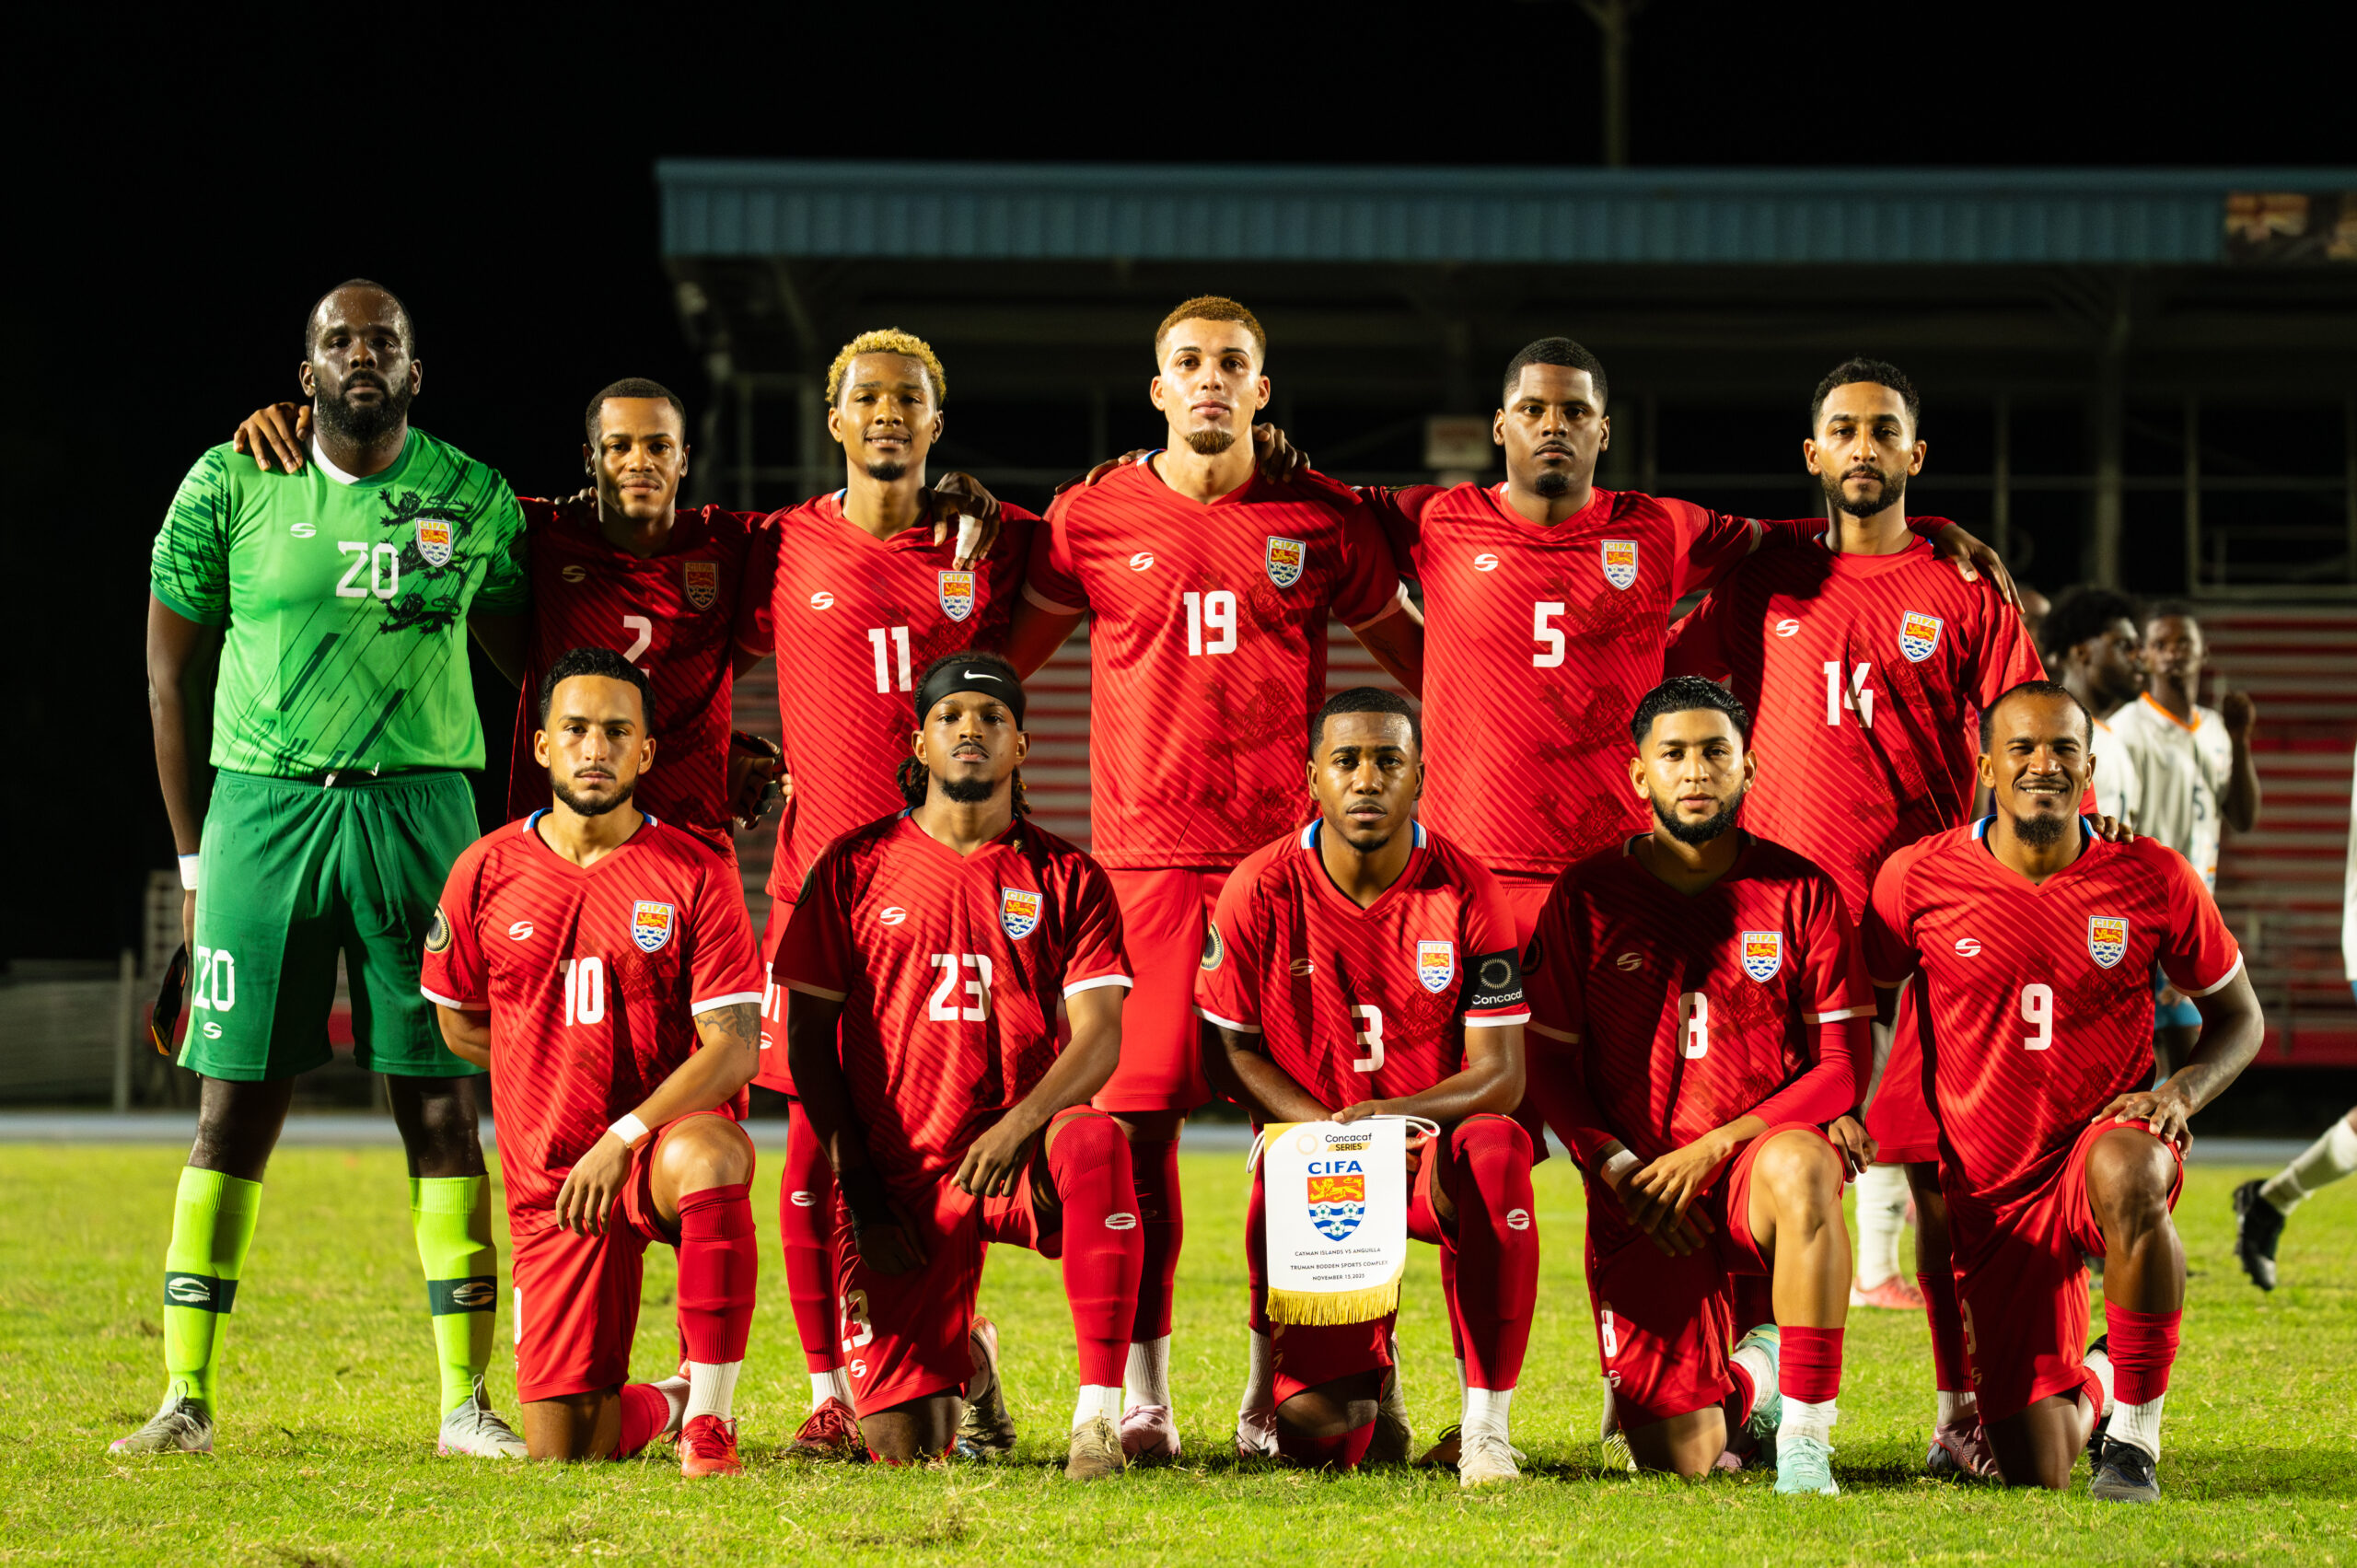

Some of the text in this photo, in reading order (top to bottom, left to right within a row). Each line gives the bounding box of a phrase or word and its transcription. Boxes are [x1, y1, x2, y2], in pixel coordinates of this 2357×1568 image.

[420, 520, 447, 530] CIFA
[1271, 540, 1300, 552] CIFA
[1606, 543, 1632, 552] CIFA
[335, 540, 400, 599] 20
[944, 574, 971, 583] CIFA
[1183, 590, 1237, 656] 19
[1533, 601, 1565, 668] 5
[1909, 613, 1937, 628] CIFA
[623, 615, 651, 679] 2
[868, 626, 911, 693] 11
[1823, 660, 1874, 728] 14
[639, 903, 668, 914] CIFA
[1007, 891, 1037, 904] CIFA
[1747, 934, 1777, 943] CIFA
[2094, 919, 2122, 929] CIFA
[1422, 944, 1449, 953] CIFA
[193, 945, 235, 1012] 20
[560, 957, 605, 1027] 10
[929, 953, 993, 1022] 23
[1678, 992, 1708, 1060] 8
[2021, 982, 2053, 1051] 9
[1352, 1005, 1385, 1073] 3
[1325, 1132, 1372, 1143] Concacaf
[1335, 1143, 1363, 1152] SERIES
[1307, 1160, 1363, 1175] CIFA
[1600, 1300, 1619, 1358] 8
